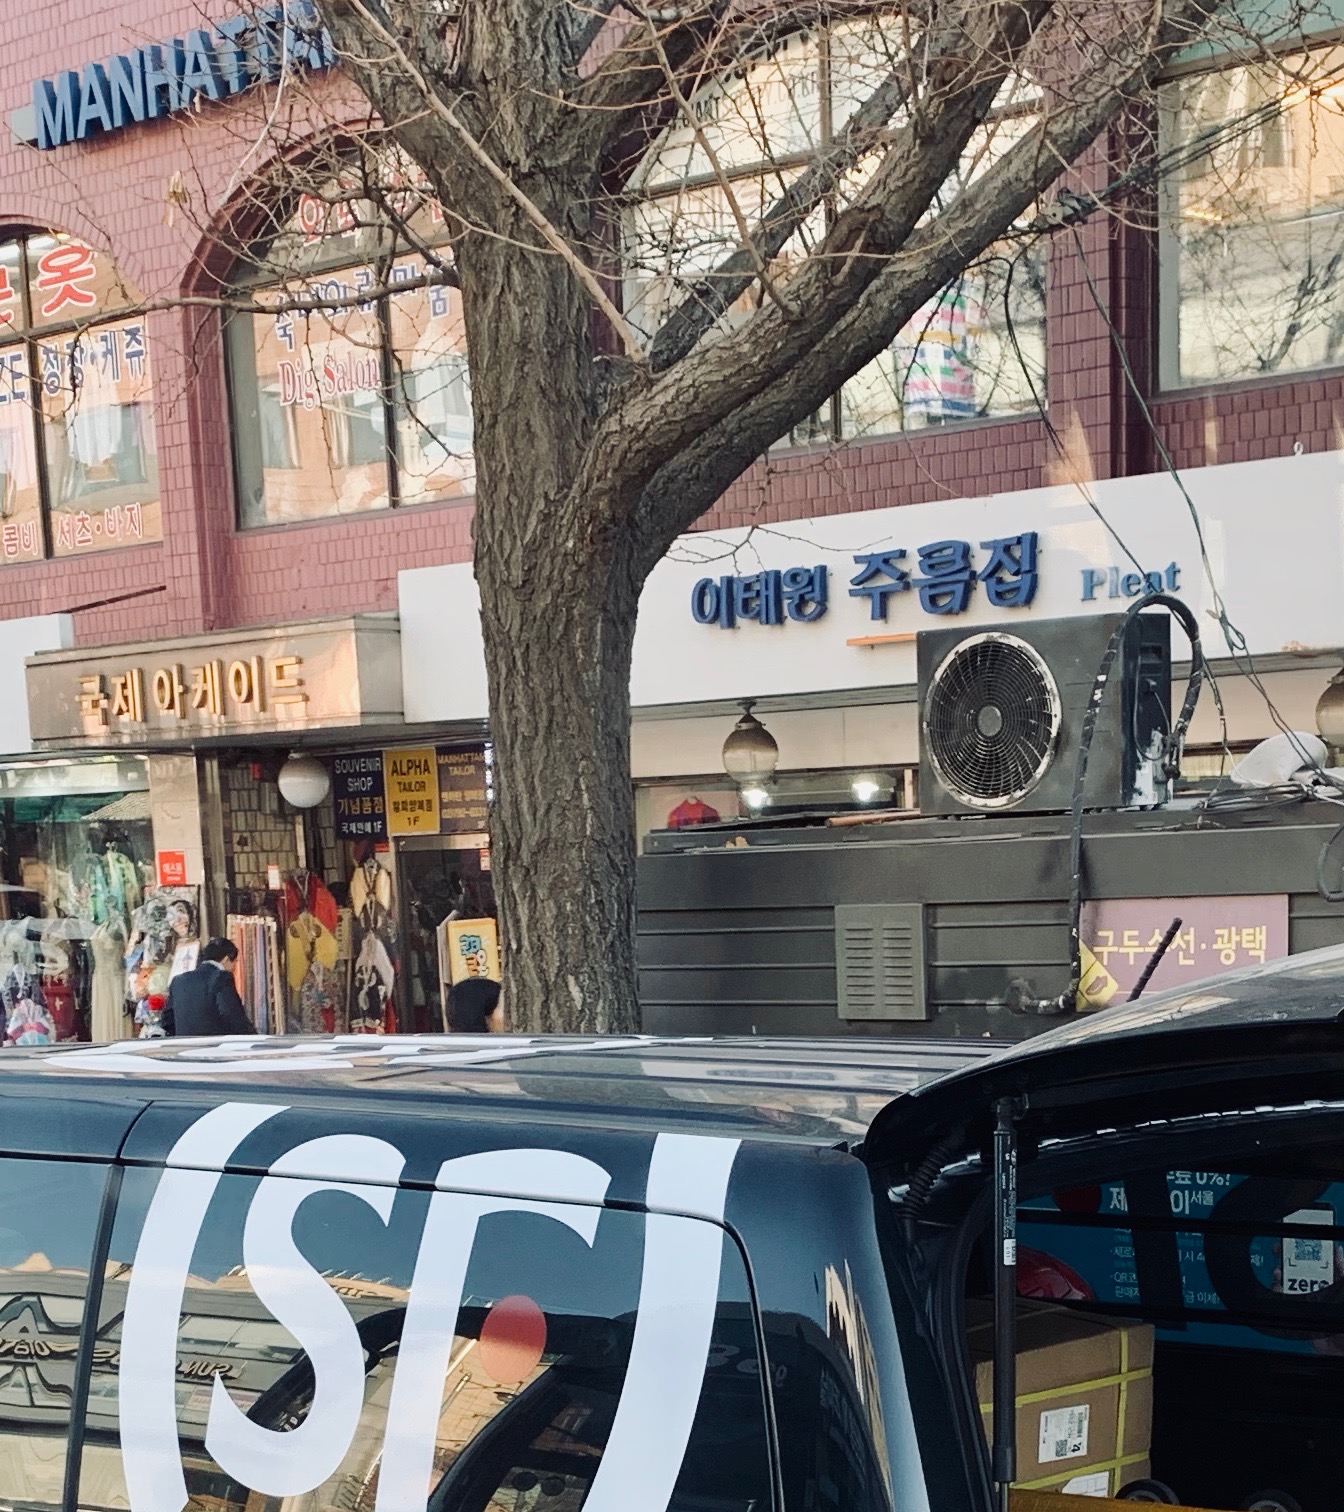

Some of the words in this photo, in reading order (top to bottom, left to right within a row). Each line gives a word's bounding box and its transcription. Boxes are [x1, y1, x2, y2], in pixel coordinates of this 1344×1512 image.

[691, 564, 830, 630] 이태원
[849, 531, 1038, 621] 주름집
[1081, 561, 1181, 601] Pleat
[335, 757, 382, 774] SOUVENIR
[391, 758, 431, 777] ALPHA
[346, 776, 374, 792] SHOP
[397, 780, 426, 794] TAILOR
[407, 815, 420, 827] 1F
[1189, 1190, 1215, 1206] 서울
